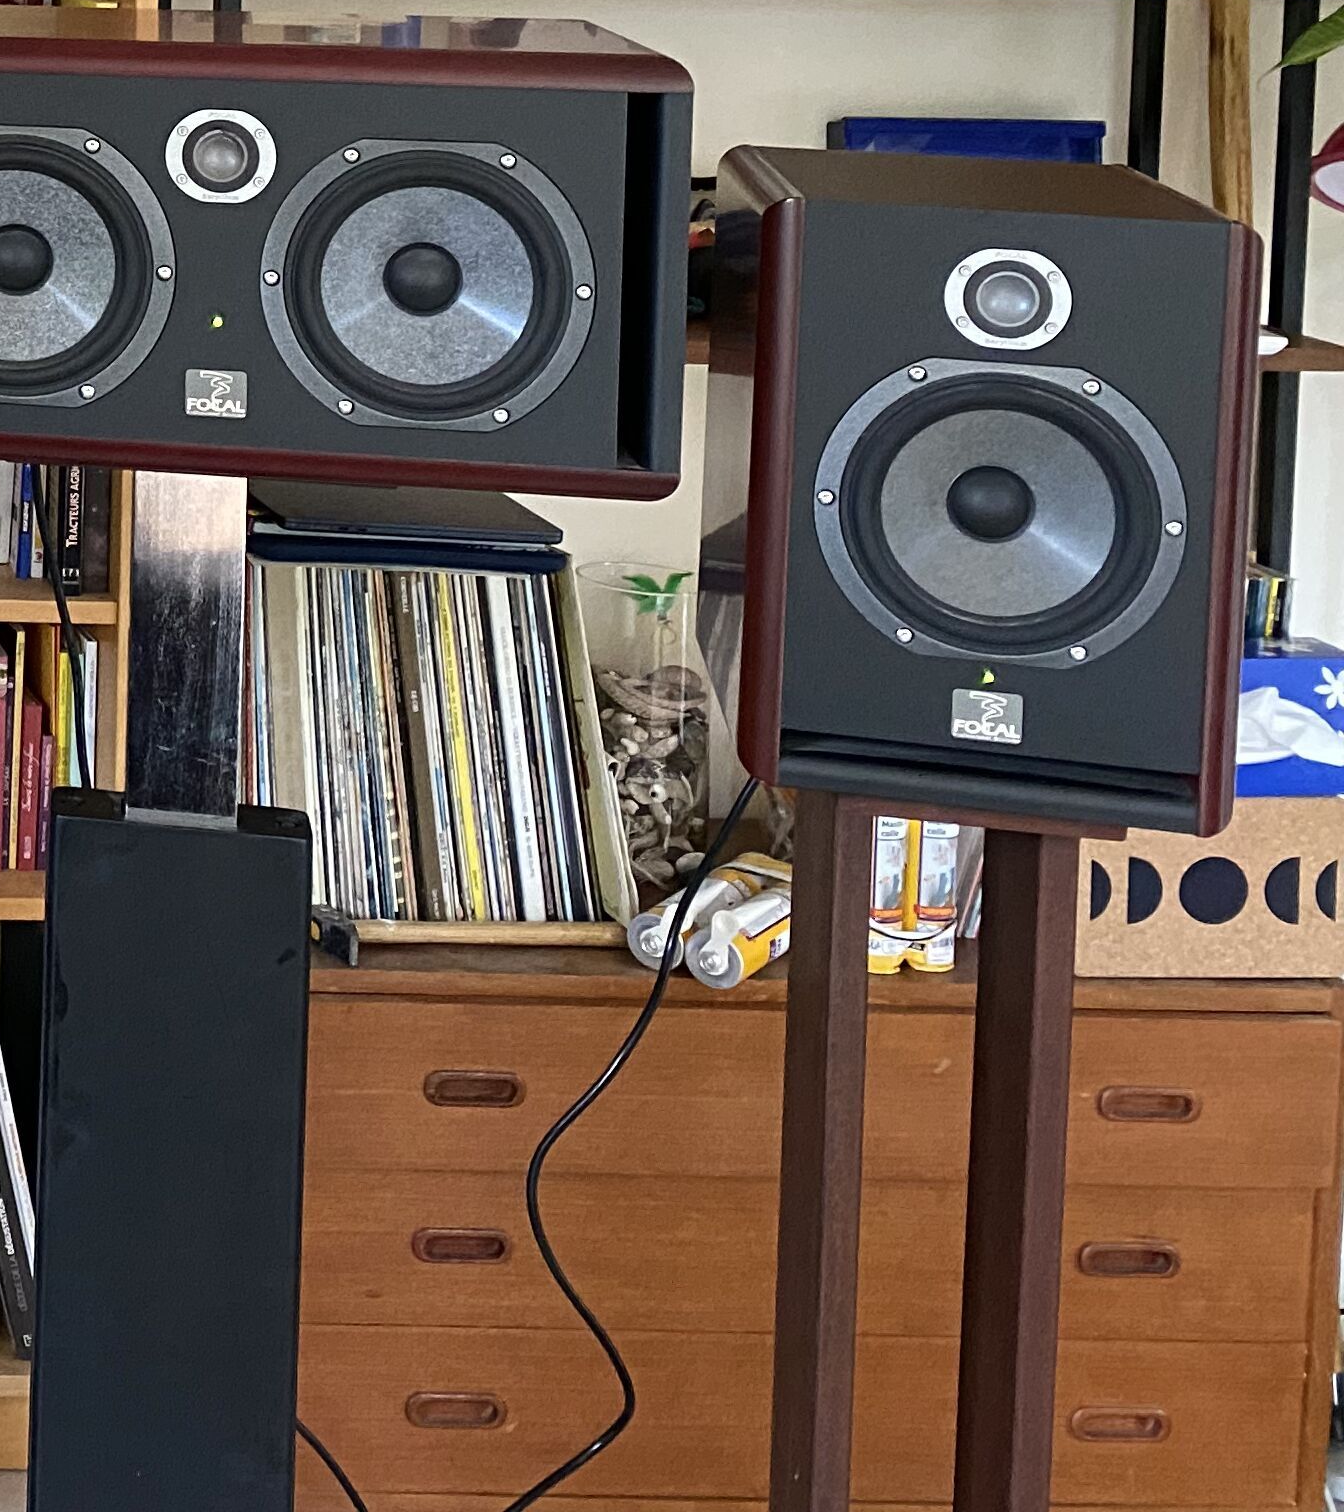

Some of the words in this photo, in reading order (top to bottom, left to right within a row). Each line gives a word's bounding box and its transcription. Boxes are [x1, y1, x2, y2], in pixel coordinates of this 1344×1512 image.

[187, 398, 246, 413] FOCAL
[65, 494, 80, 548] TRACTEURS
[953, 719, 1021, 739] FOCAL
